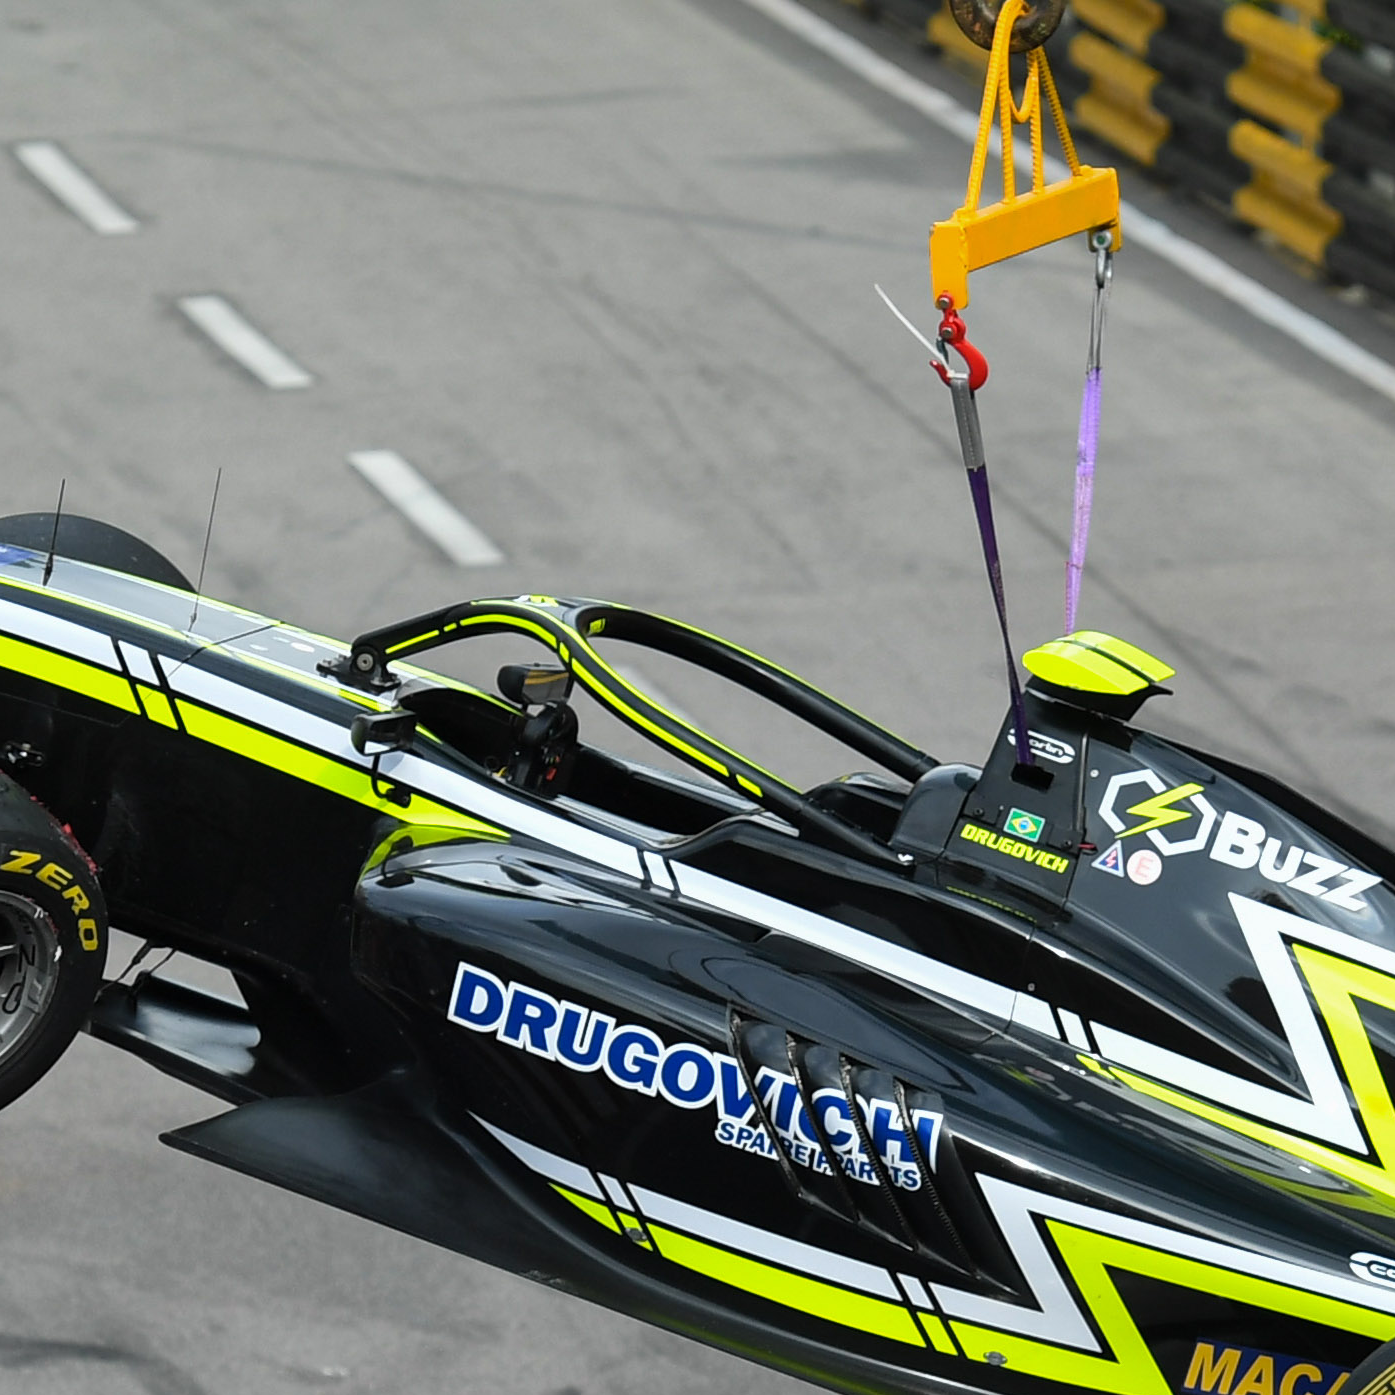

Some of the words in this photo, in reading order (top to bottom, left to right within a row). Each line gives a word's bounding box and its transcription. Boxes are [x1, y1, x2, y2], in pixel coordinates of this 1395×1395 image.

[960, 823, 1069, 874] DRUGOVICH
[0, 850, 98, 951] ZERO
[449, 963, 942, 1170] DRUGOVICH
[717, 1121, 809, 1165] SPARE
[813, 1154, 920, 1190] PARTS
